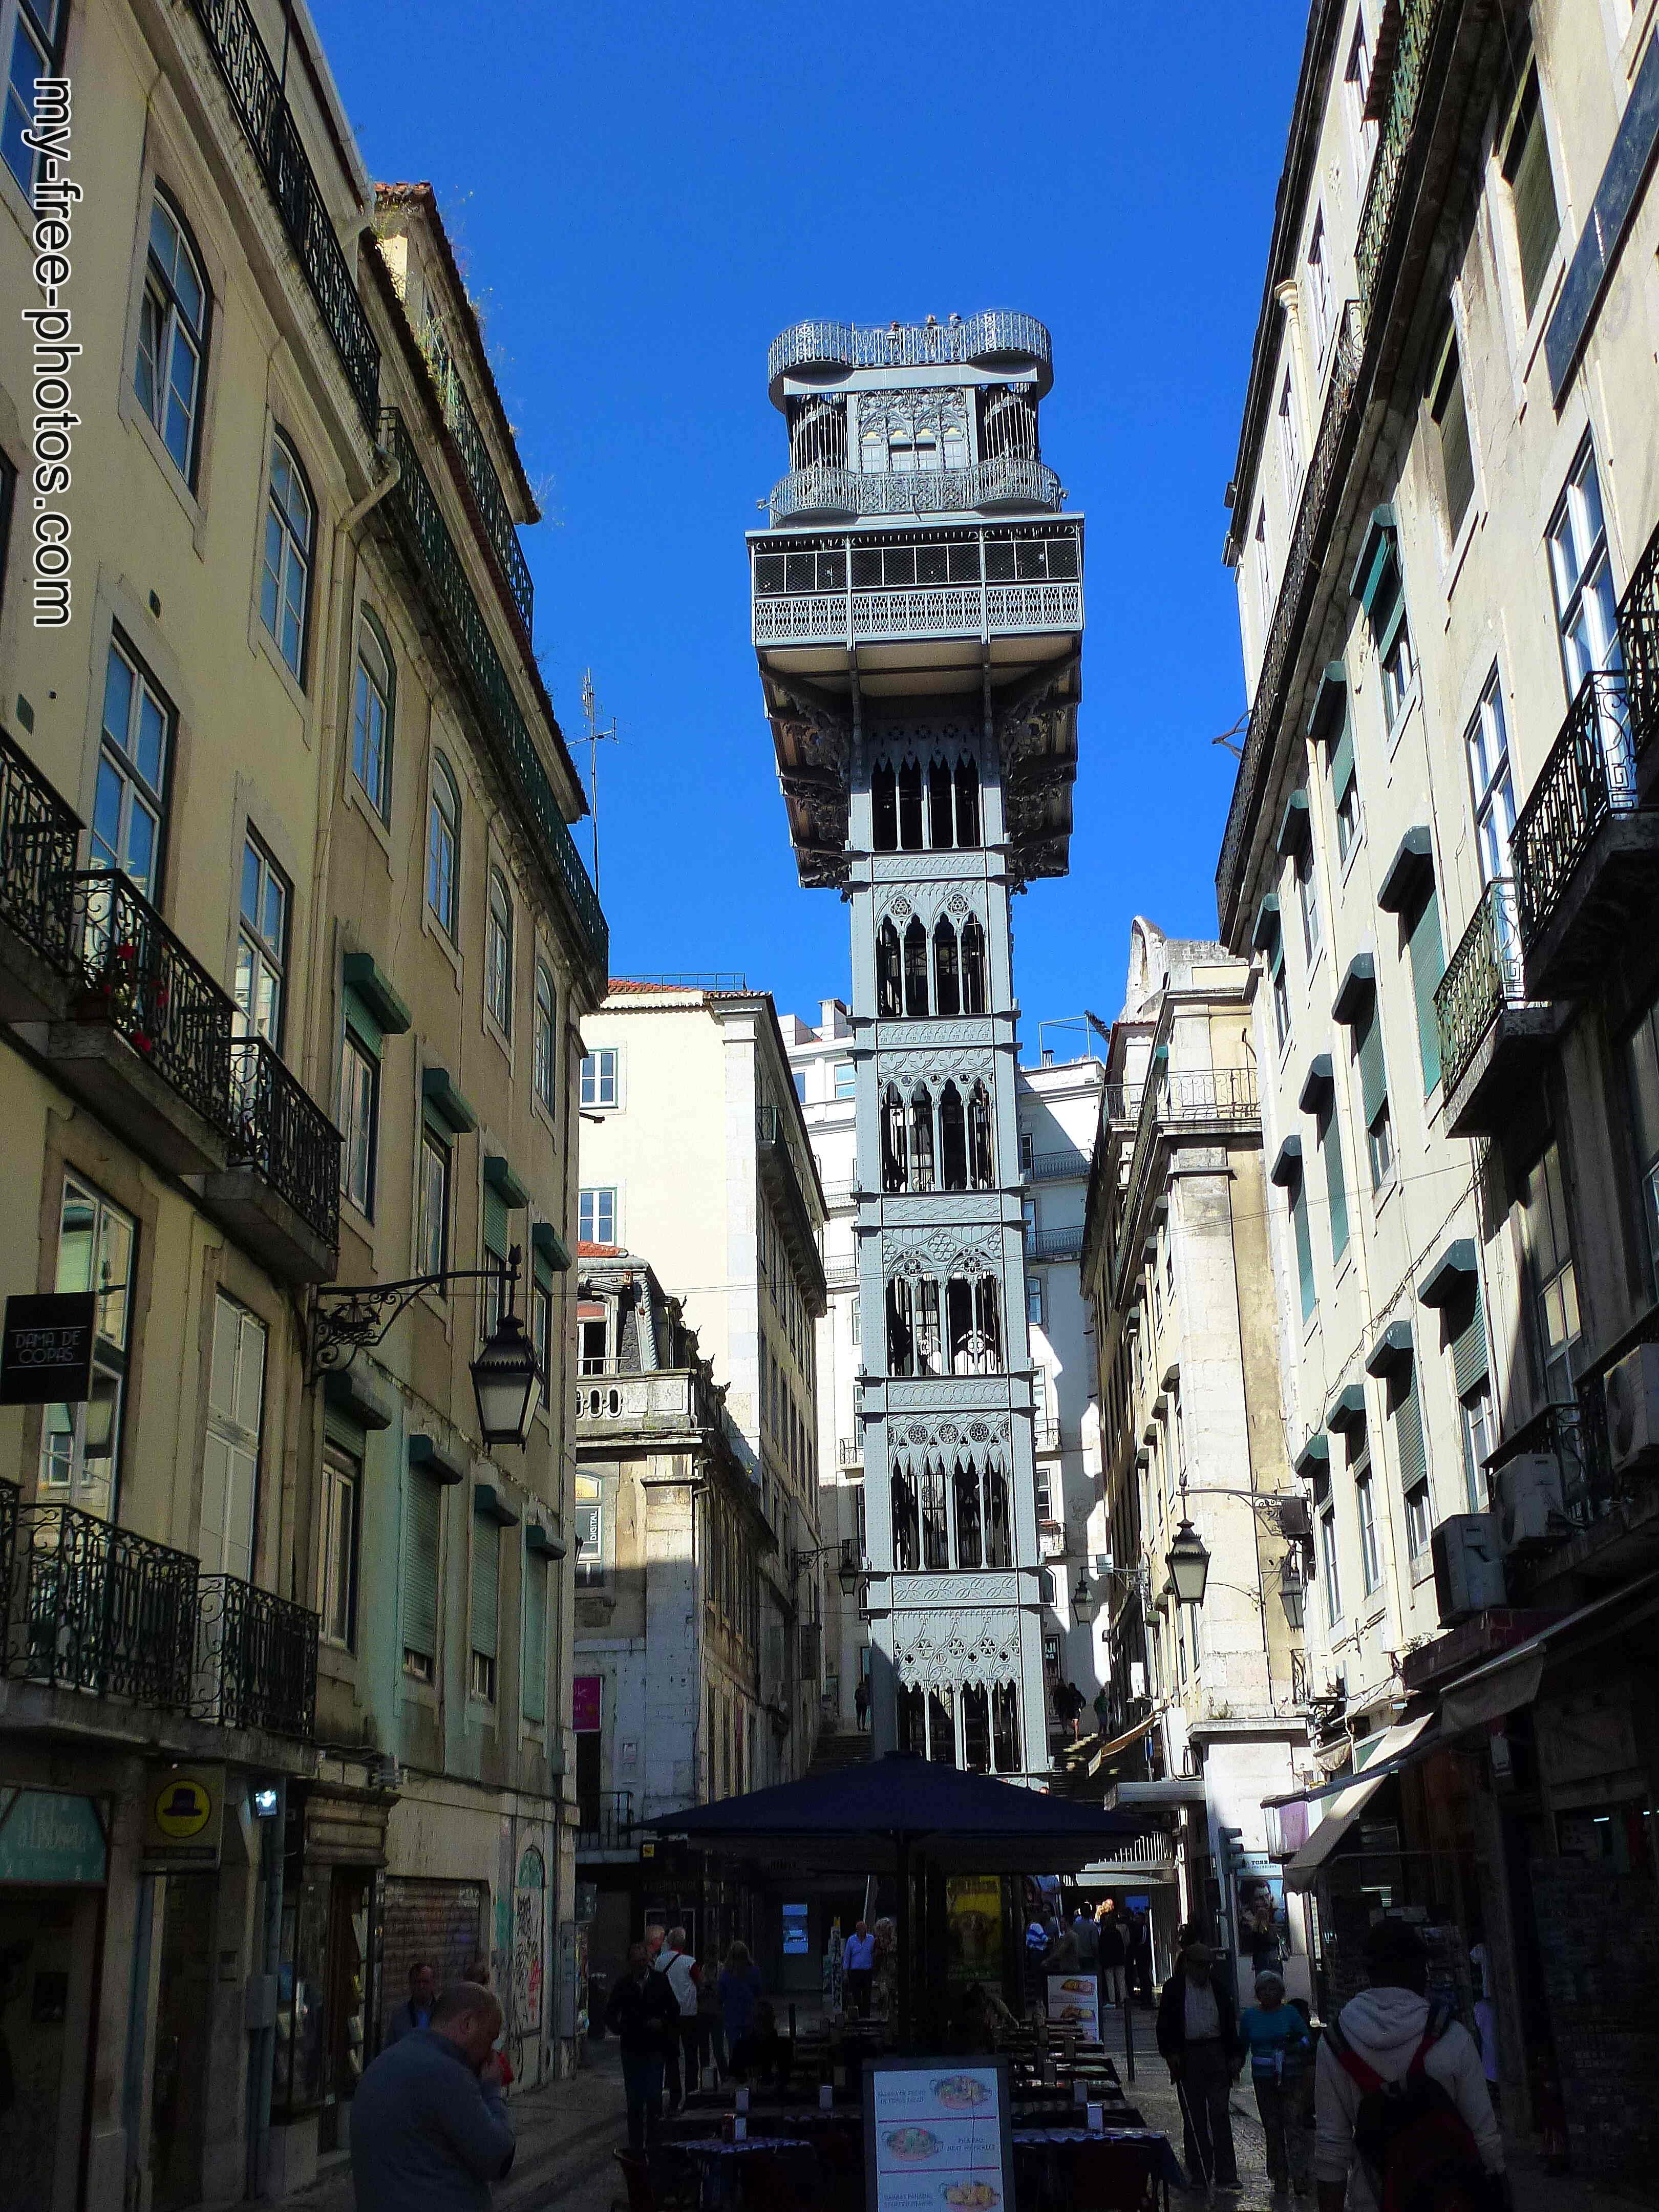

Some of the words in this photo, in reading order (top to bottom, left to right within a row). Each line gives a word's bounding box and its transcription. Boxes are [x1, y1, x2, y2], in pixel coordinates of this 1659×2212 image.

[16, 1332, 55, 1348] DAMA
[62, 1331, 80, 1346] DE
[19, 1347, 74, 1363] COPAS
